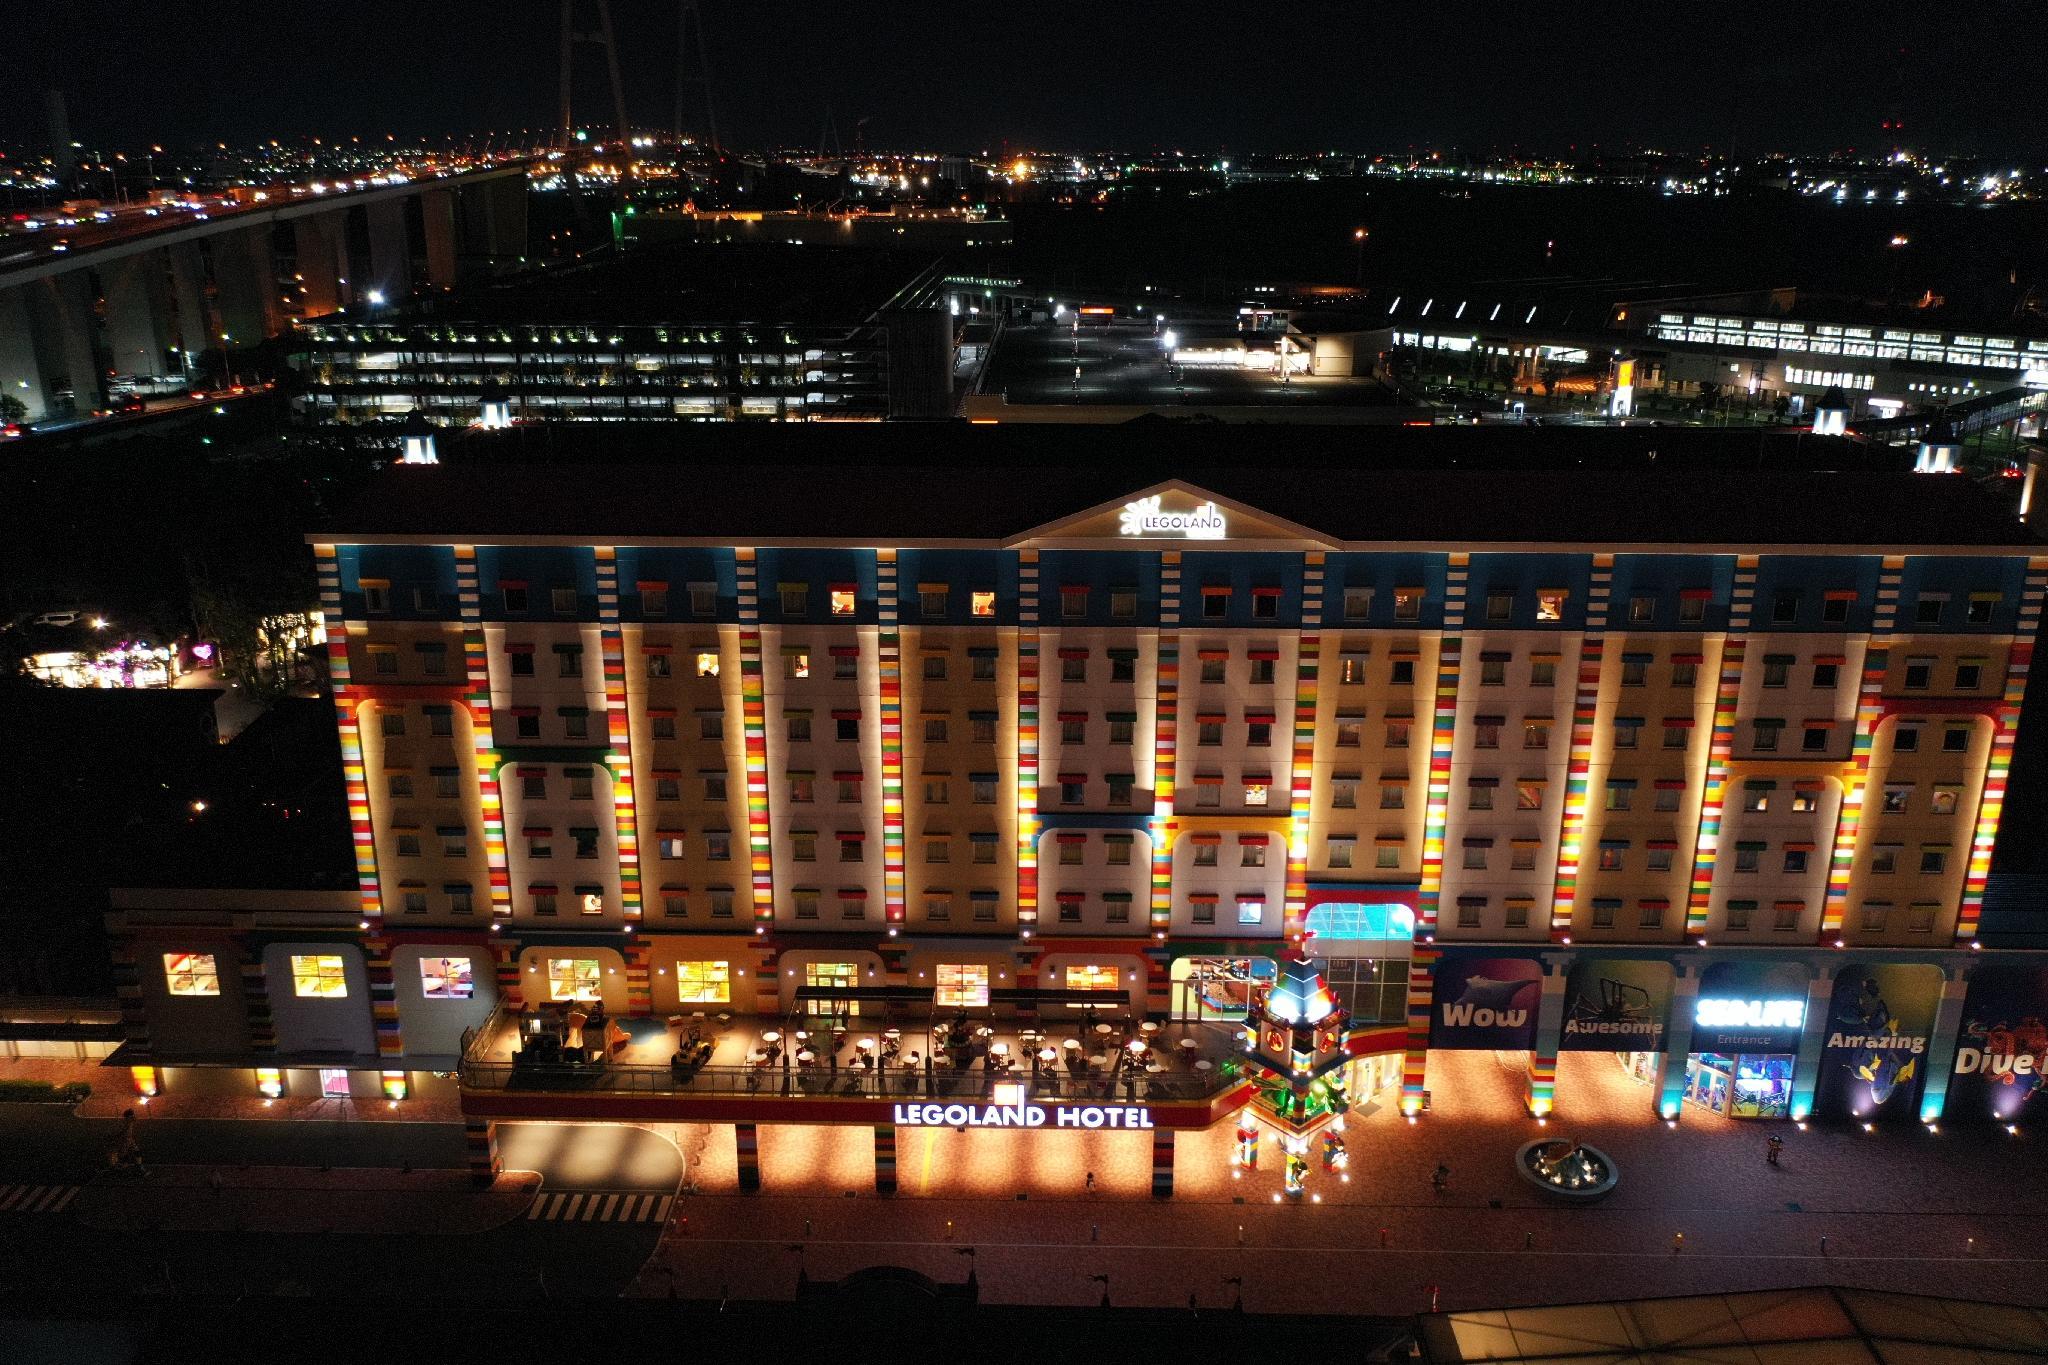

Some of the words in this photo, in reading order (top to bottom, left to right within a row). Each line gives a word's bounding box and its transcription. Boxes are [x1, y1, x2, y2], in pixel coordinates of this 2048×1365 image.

[1145, 505, 1222, 528] LEGOLAND
[1442, 1003, 1528, 1027] Wow
[1565, 1020, 1664, 1035] Awesome
[1717, 1034, 1772, 1045] Entrance
[1827, 1033, 1926, 1053] Amazing
[1955, 1046, 2035, 1075] Dive
[895, 1085, 1045, 1126] LEGOLAND
[1057, 1107, 1154, 1128] HOTEL
